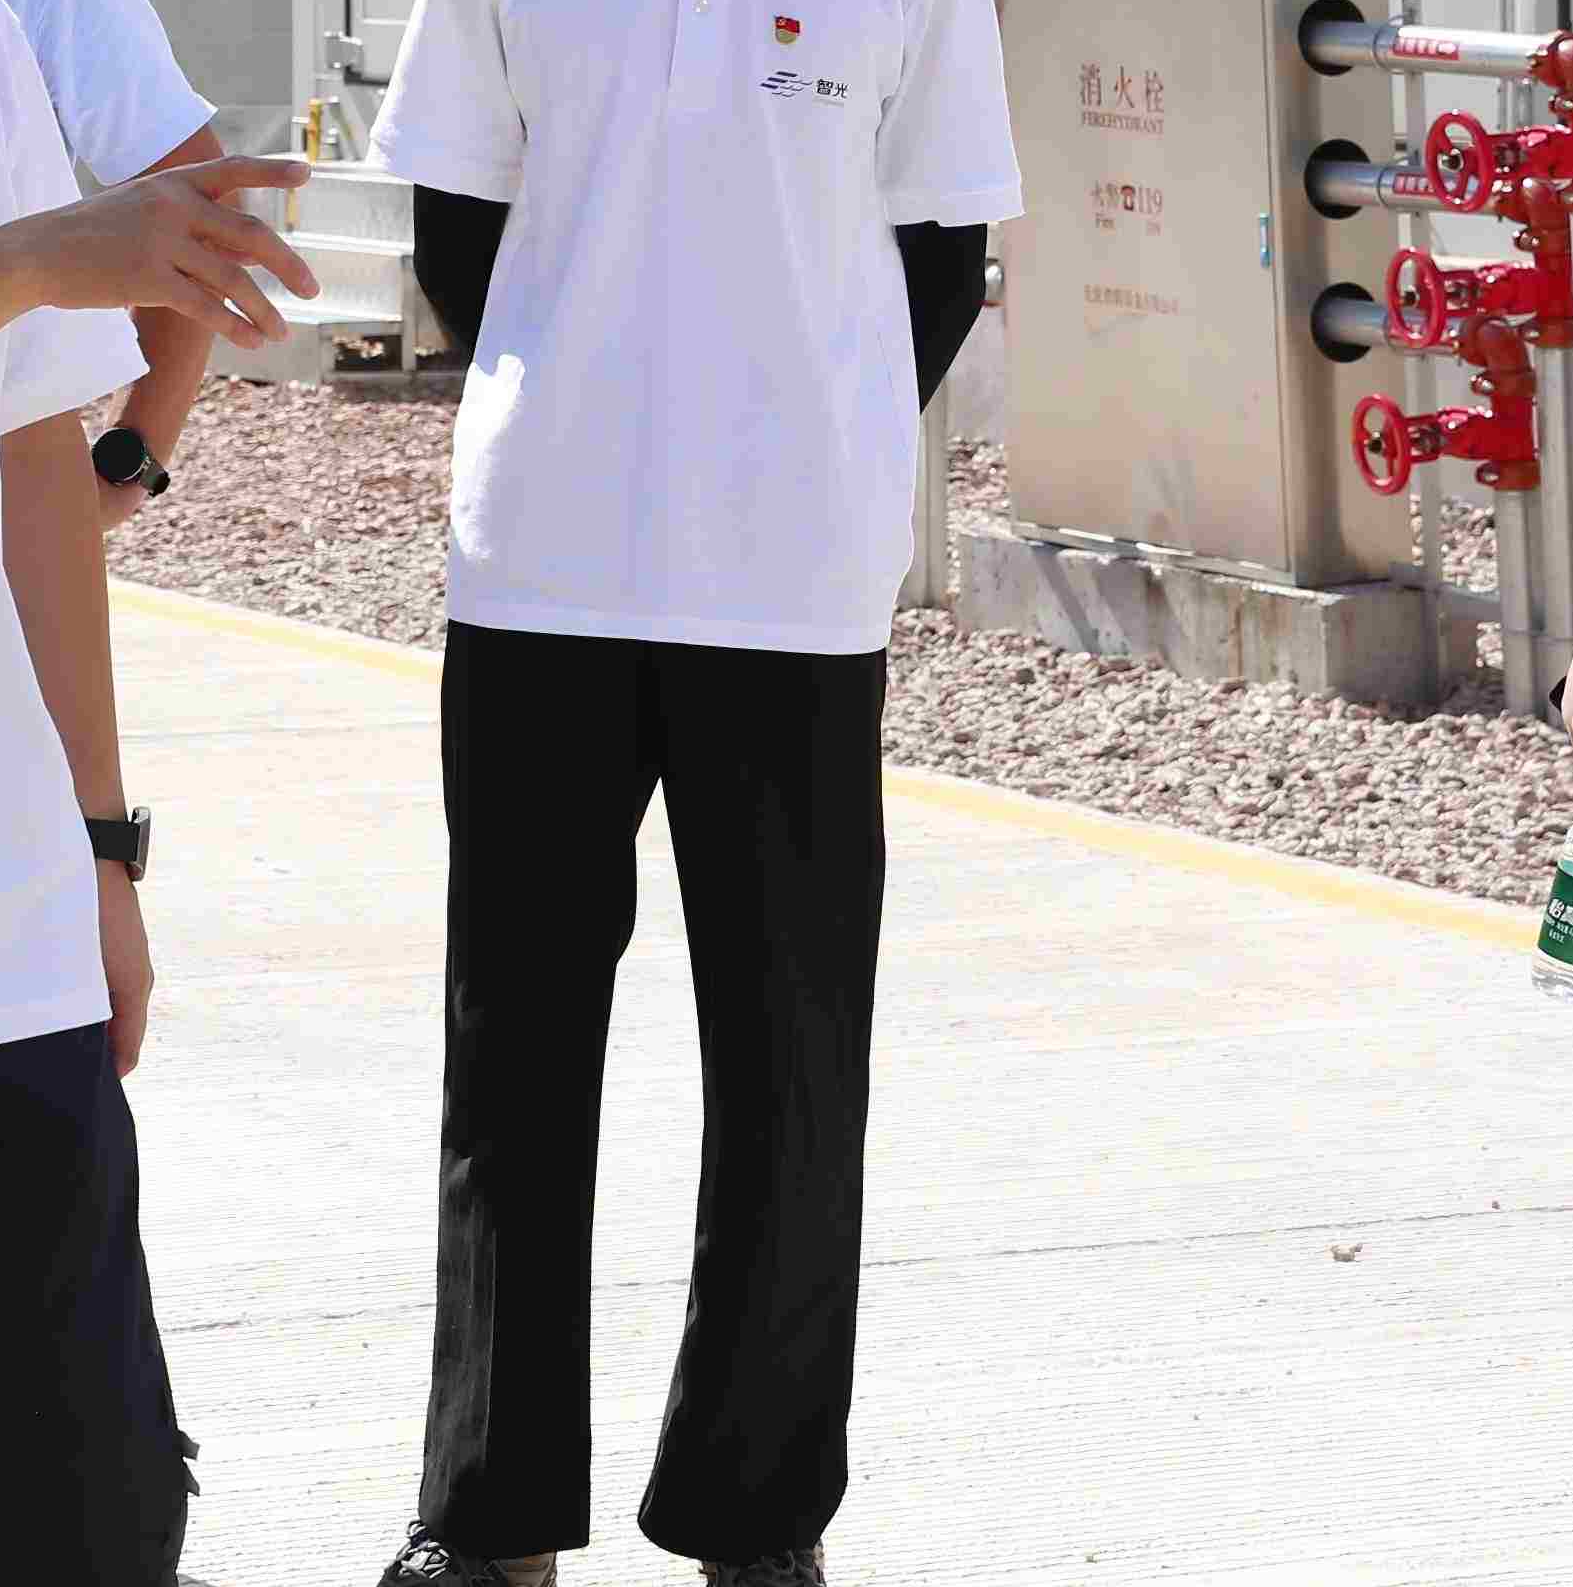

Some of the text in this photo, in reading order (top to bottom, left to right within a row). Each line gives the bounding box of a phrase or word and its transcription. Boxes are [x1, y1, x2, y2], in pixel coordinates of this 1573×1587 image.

[816, 78, 849, 99] 智光
[1080, 62, 1165, 113] 消火栓
